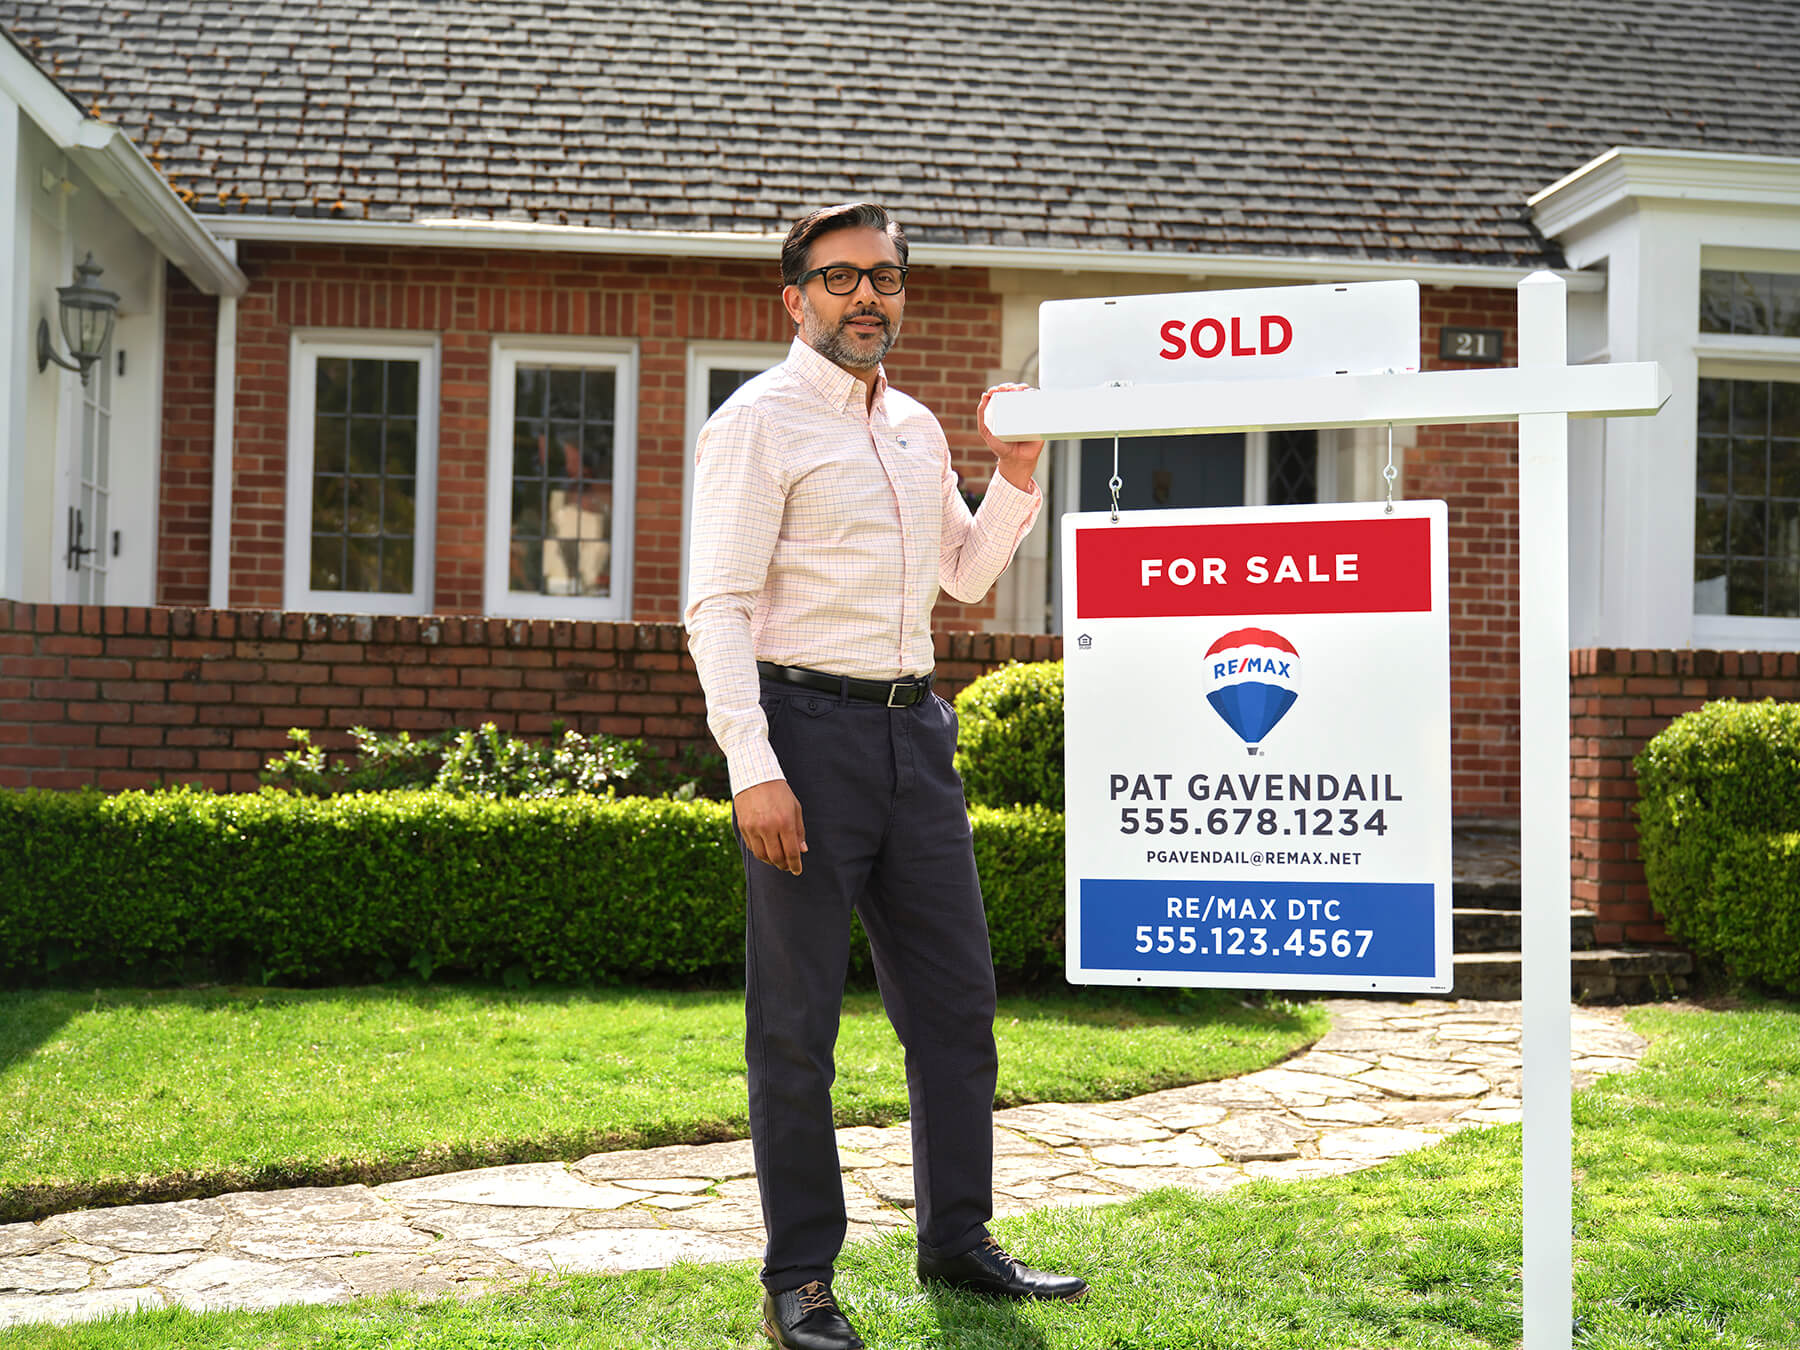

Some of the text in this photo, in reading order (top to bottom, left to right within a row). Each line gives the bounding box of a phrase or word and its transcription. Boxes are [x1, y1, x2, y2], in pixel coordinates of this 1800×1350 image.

[1159, 314, 1293, 361] SOLD
[1456, 332, 1488, 357] 21
[1141, 553, 1360, 587] FOR SALE
[1213, 657, 1291, 680] RE/MAX
[1110, 774, 1403, 802] PAT GAVENDAIL
[1119, 807, 1388, 836] 555.678.1234
[1147, 850, 1362, 867] PGAVENDAIL@REMAX.NET
[1166, 895, 1341, 923] RE/MAX DTC
[1134, 925, 1375, 959] 555.123.4567
